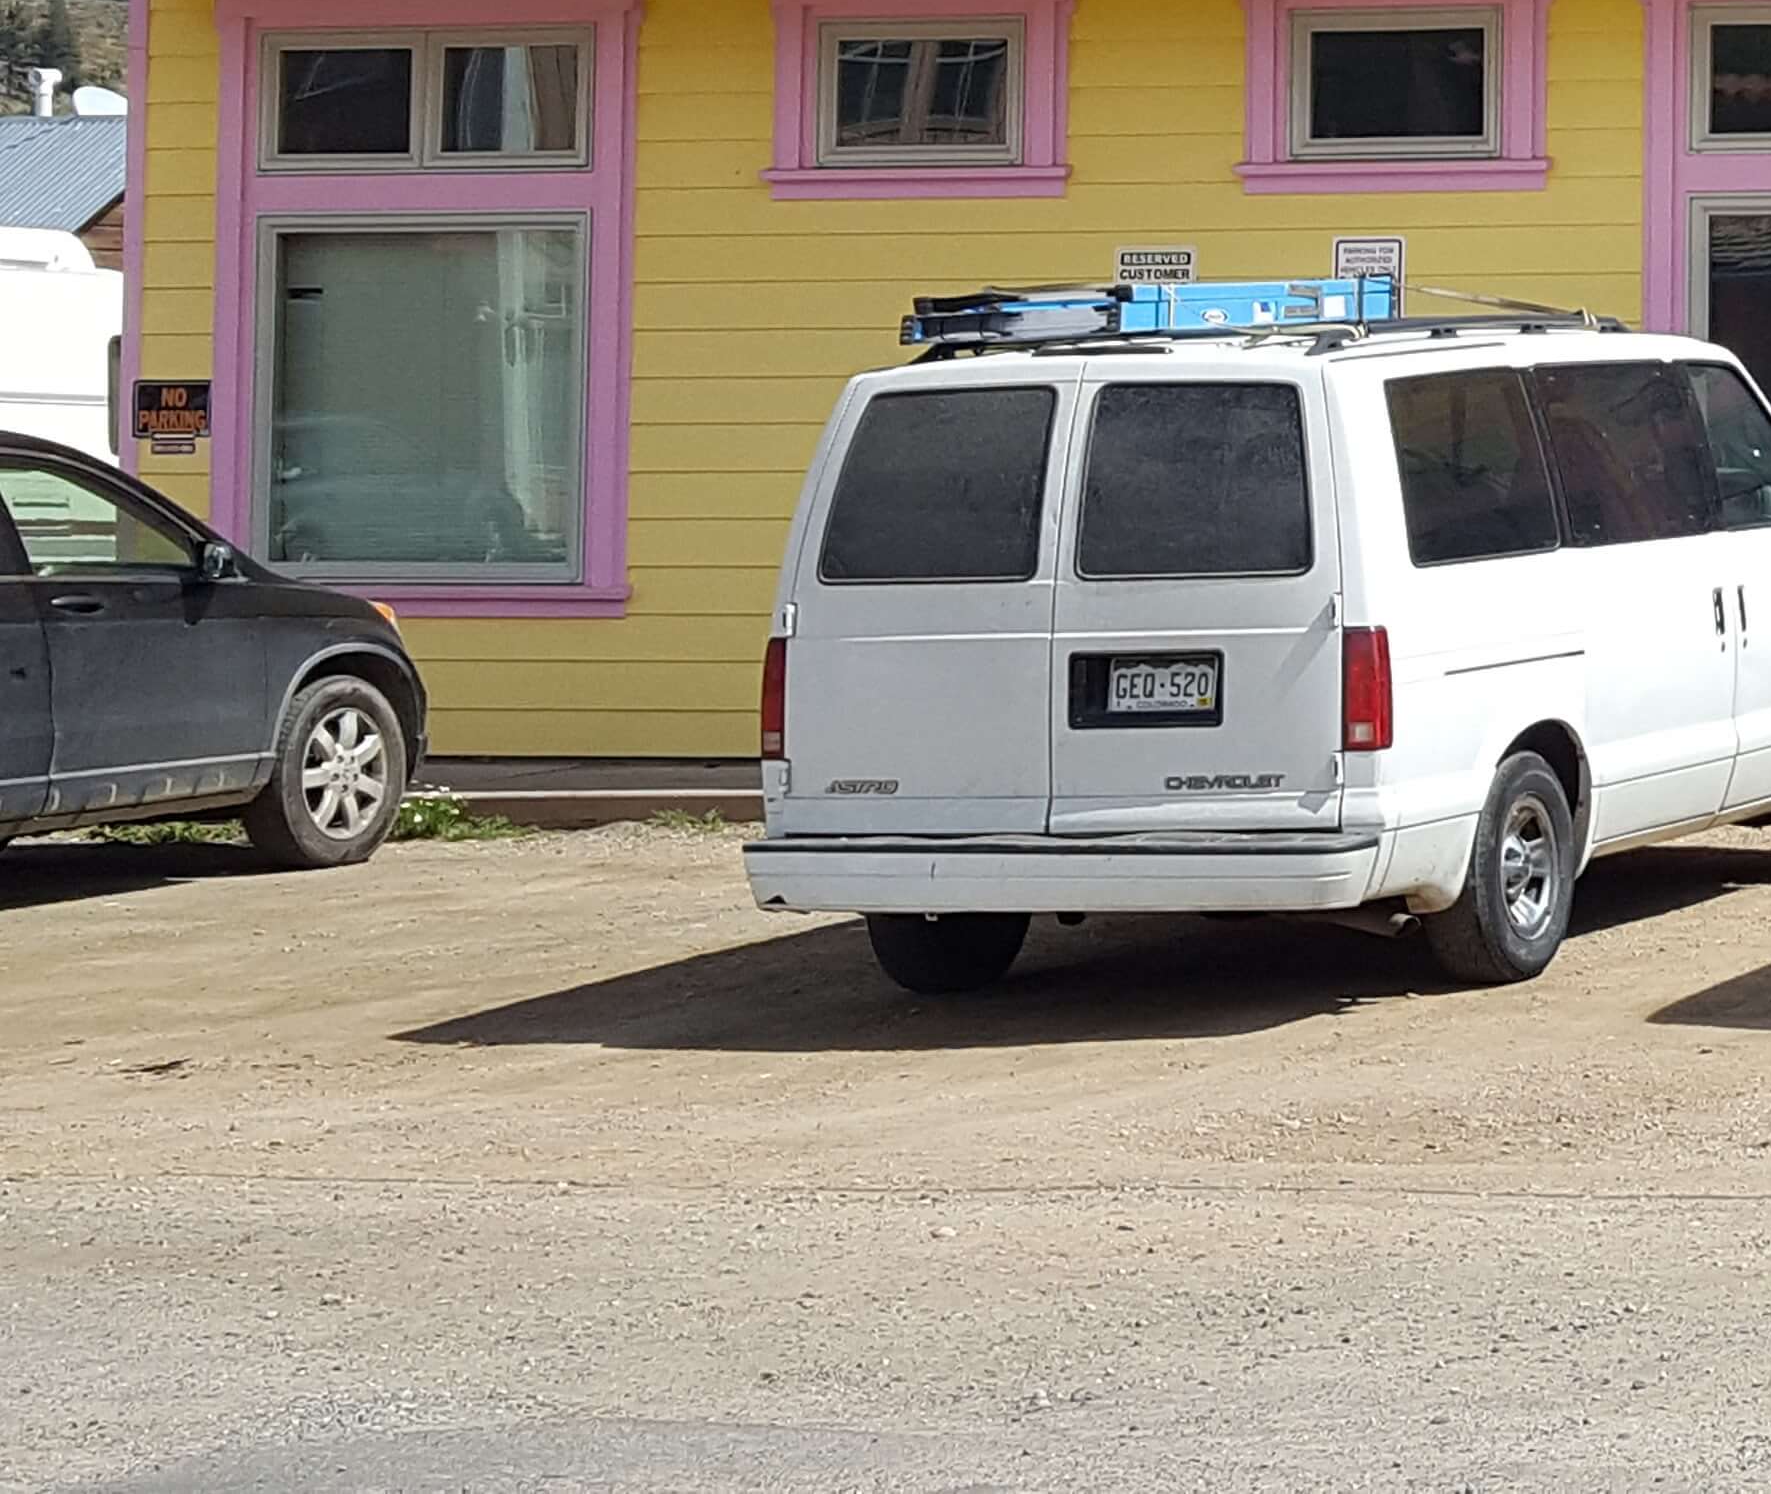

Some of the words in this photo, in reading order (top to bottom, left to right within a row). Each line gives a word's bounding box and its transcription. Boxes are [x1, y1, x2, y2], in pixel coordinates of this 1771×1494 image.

[1122, 253, 1189, 265] RESERVED
[1119, 268, 1190, 281] CUSTOMER
[160, 387, 188, 407] NO
[138, 409, 207, 430] PARKING
[824, 779, 899, 795] ASTRO
[1164, 772, 1286, 791] CHEVROLET
